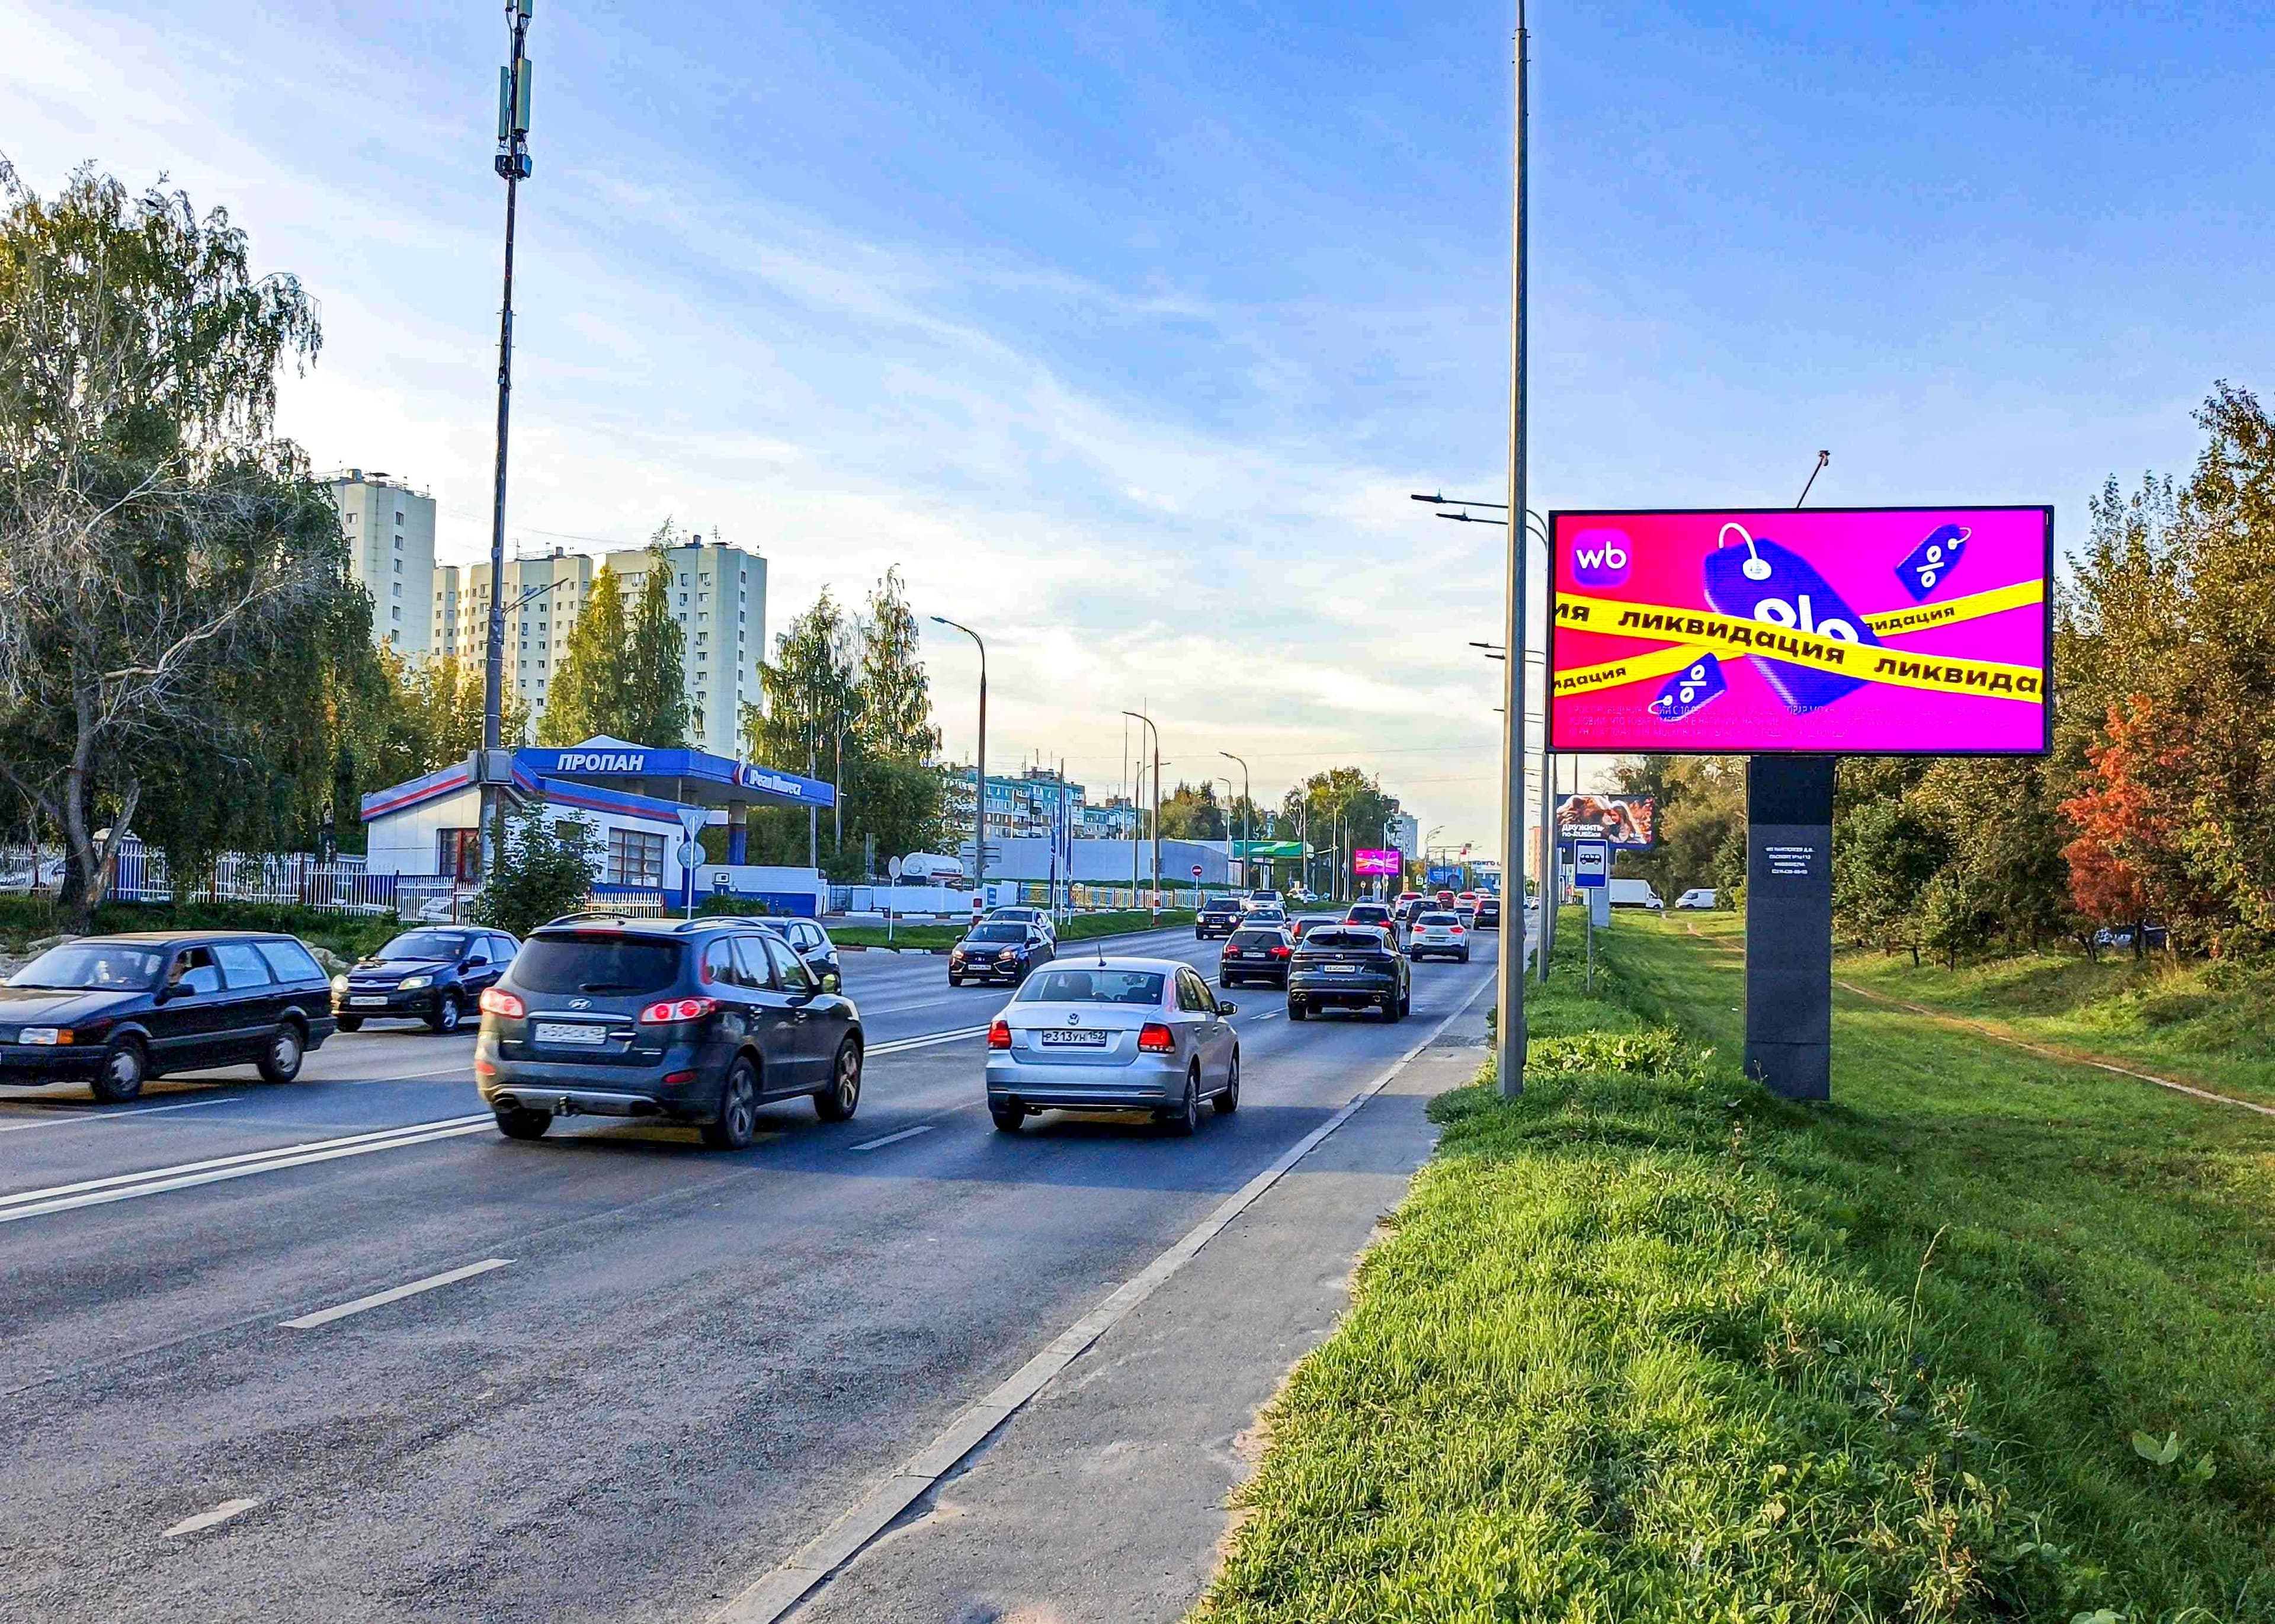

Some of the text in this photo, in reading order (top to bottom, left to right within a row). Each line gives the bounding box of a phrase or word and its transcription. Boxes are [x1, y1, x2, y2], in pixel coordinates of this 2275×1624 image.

[1575, 541, 1627, 569] wb
[1617, 611, 1845, 664] ликвидация
[1873, 658, 2043, 694] ликвида
[557, 754, 644, 771] ПРОПАН
